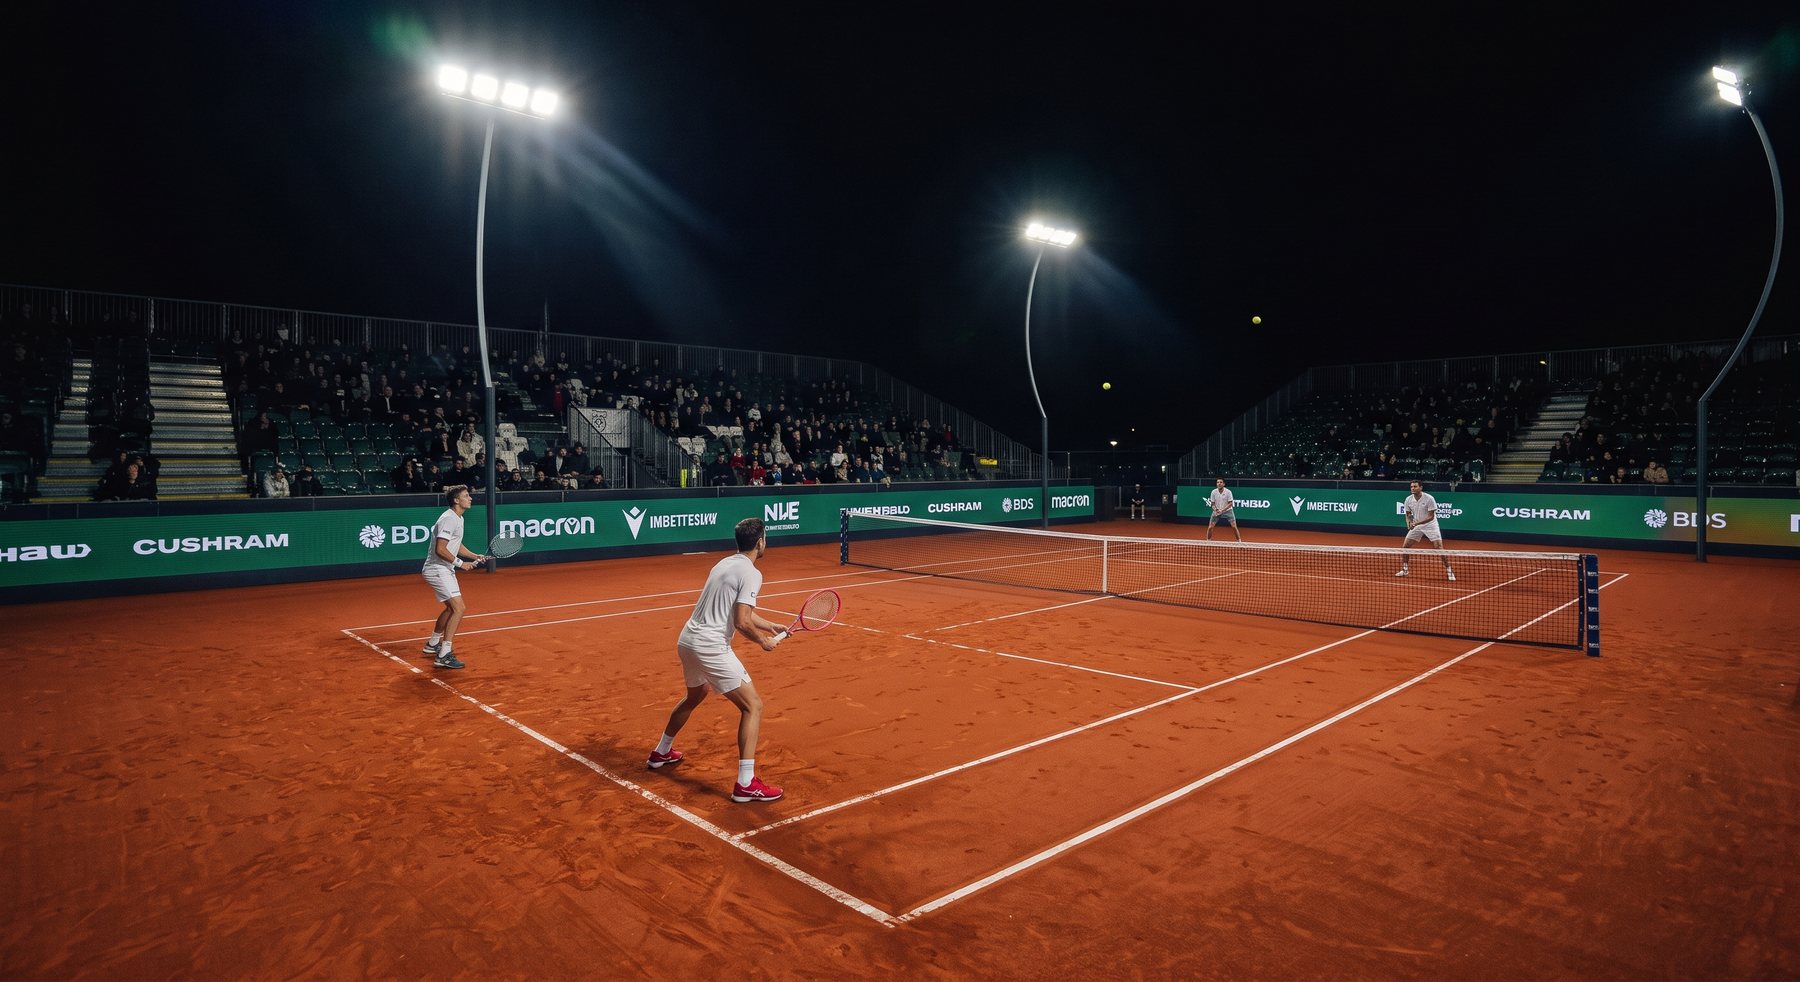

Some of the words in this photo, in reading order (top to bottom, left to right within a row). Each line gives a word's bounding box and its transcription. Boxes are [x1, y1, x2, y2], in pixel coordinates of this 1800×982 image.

[927, 501, 982, 513] CUSHRAM
[1013, 498, 1034, 511] BDS
[1051, 494, 1090, 509] macron
[1492, 506, 1591, 521] CUSHRAM
[391, 525, 435, 545] BD
[499, 516, 595, 539] macron
[133, 533, 289, 556] CUSHRAM
